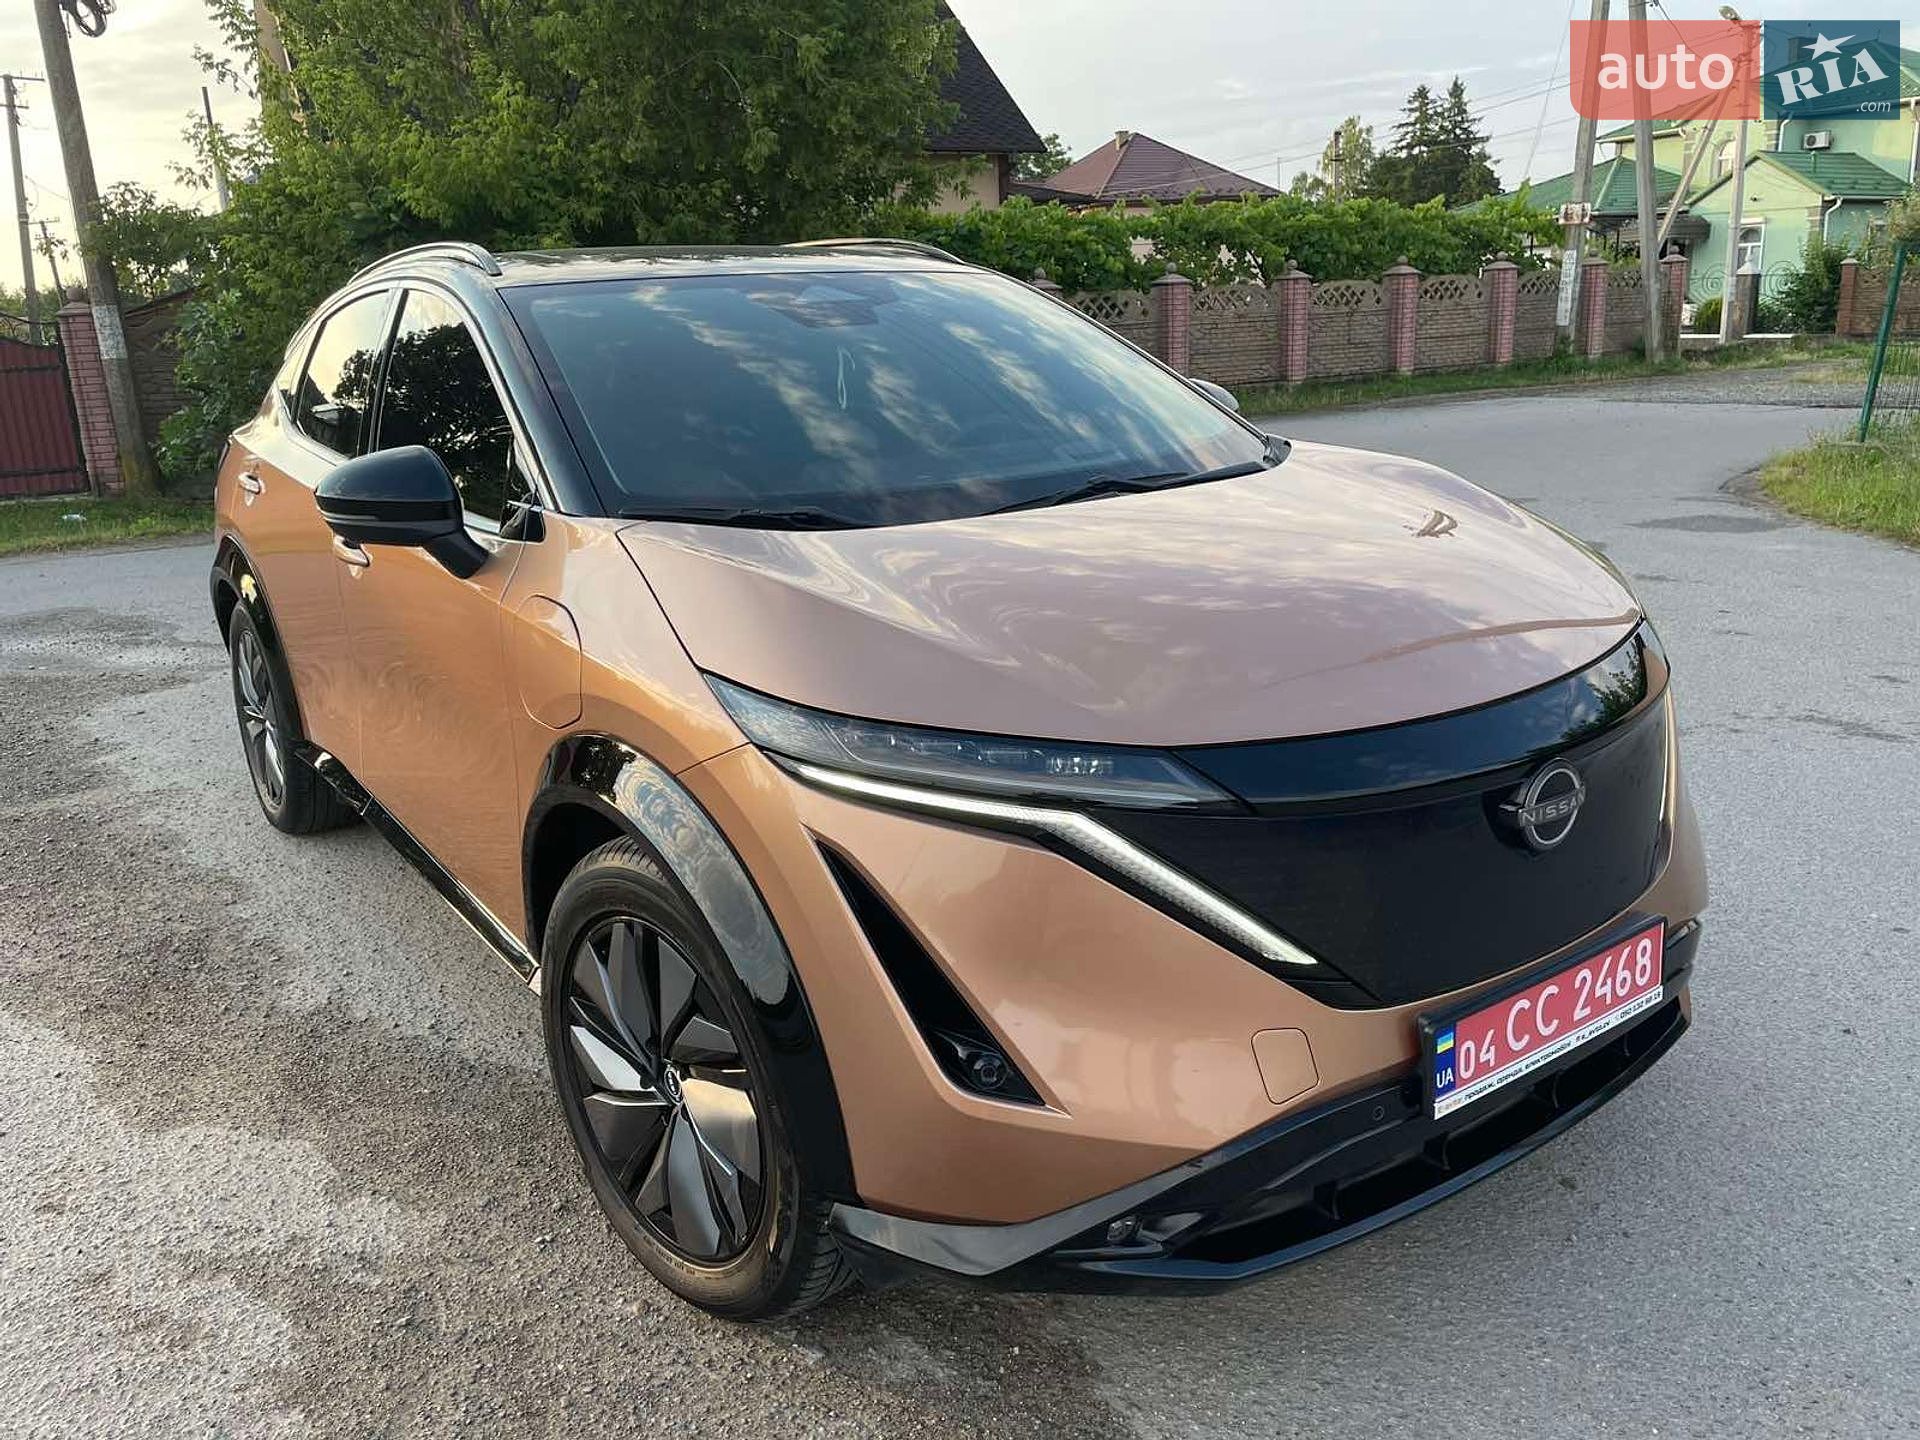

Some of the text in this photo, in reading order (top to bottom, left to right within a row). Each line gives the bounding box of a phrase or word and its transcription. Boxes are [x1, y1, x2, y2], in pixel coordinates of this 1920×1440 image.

[1459, 1028, 1496, 1080] 04
[1506, 984, 1560, 1052] CC
[1572, 937, 1652, 1022] 2468
[1436, 1067, 1454, 1089] UA
